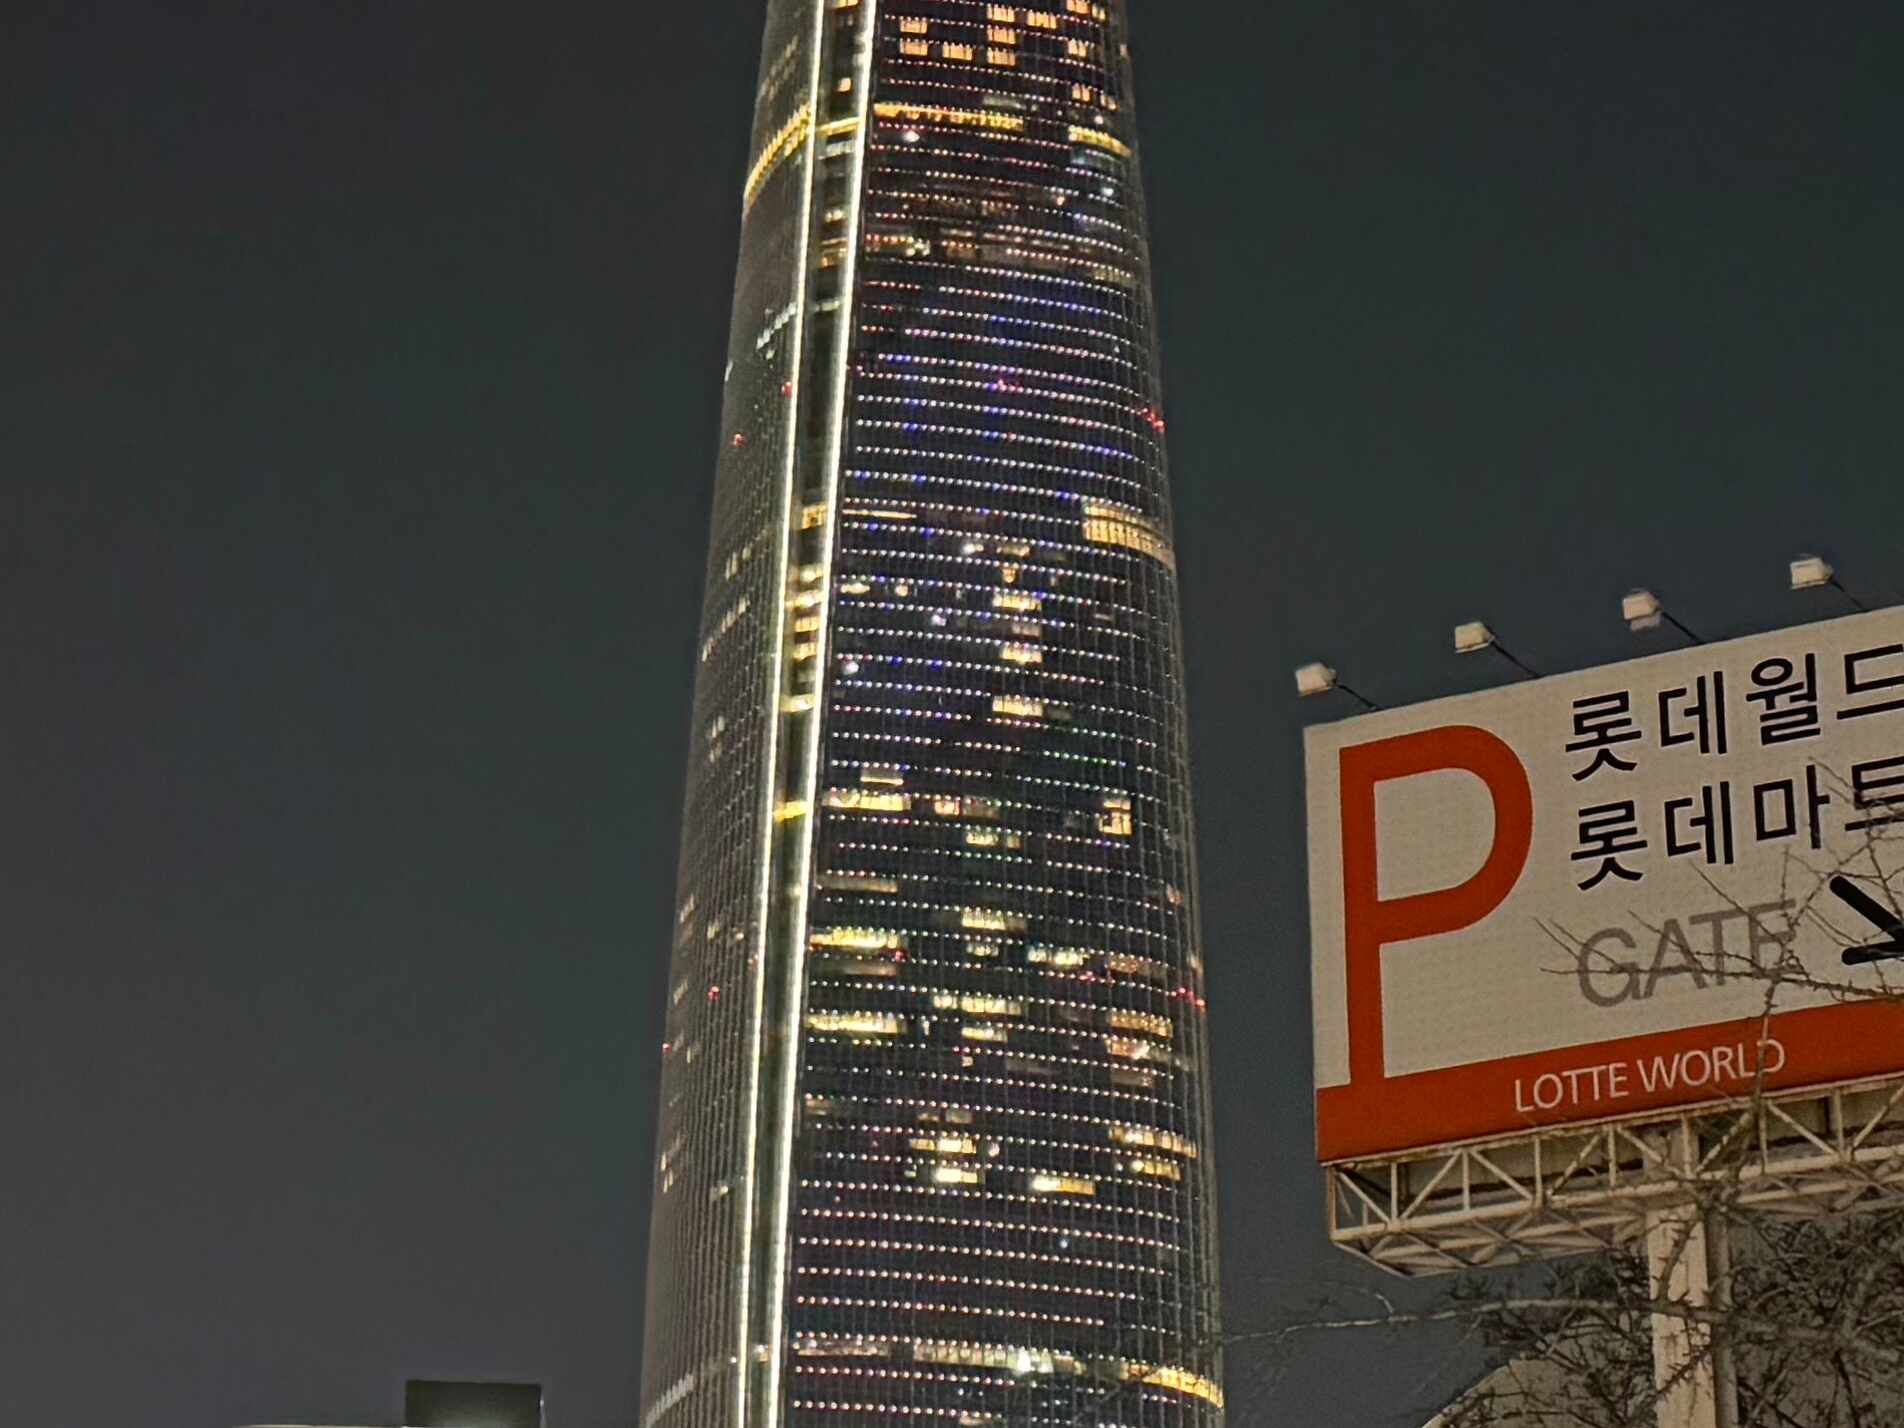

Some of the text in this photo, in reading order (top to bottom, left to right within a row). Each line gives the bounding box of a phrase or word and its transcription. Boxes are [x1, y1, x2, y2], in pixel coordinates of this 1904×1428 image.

[1340, 725, 1533, 1084] P
[1577, 900, 1802, 1008] GATE
[1514, 1037, 1786, 1114] LOTTE WORLD
